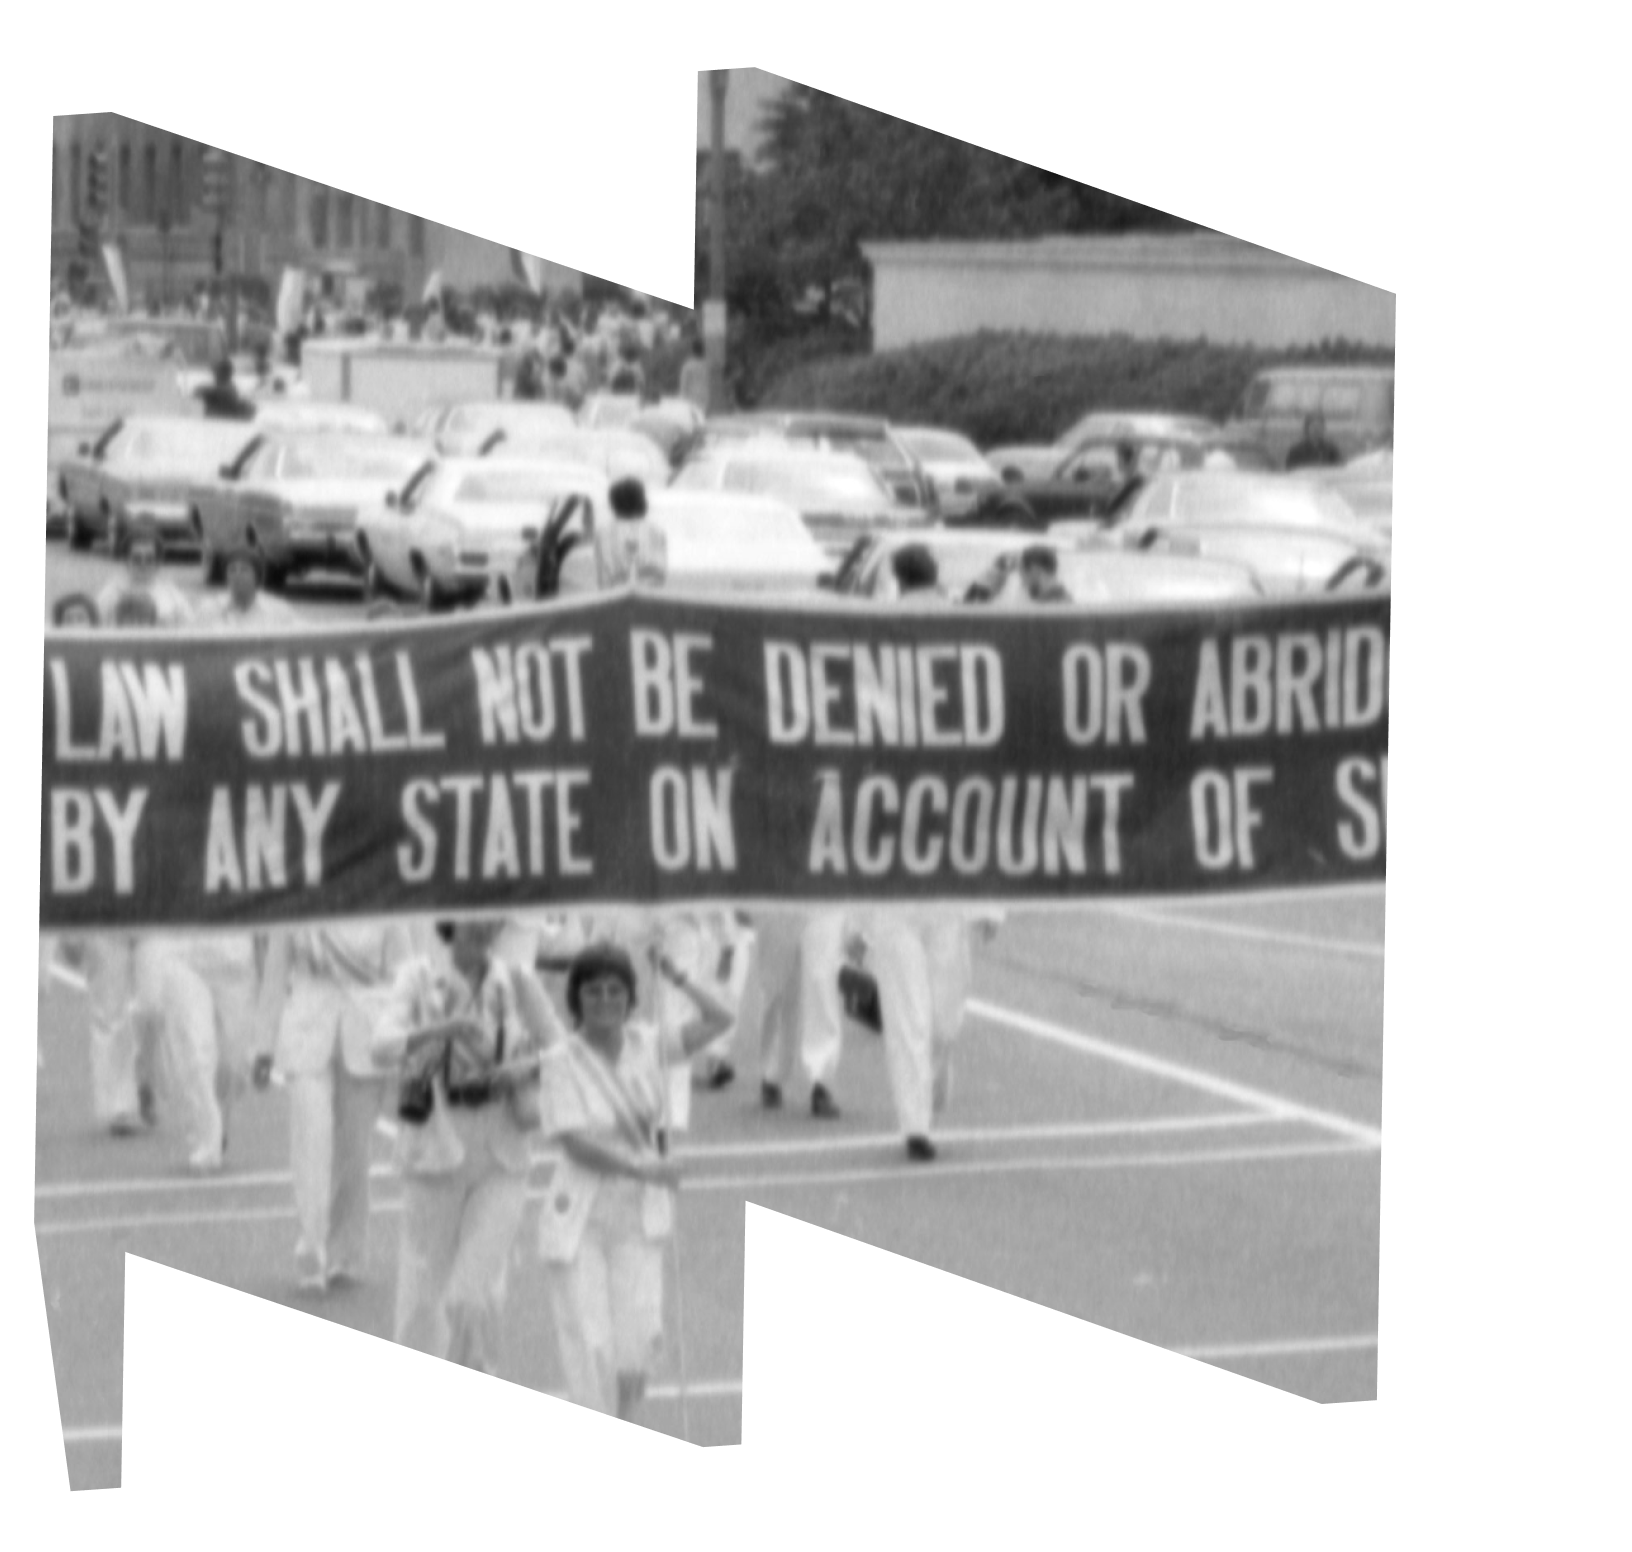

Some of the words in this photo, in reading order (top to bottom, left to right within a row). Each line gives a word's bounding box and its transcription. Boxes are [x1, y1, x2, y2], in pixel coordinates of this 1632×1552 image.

[50, 655, 188, 763] LAW
[232, 648, 446, 760] SHALL
[469, 633, 594, 746] NOT
[629, 627, 718, 739] BE
[762, 638, 1006, 748] DENIED
[1060, 641, 1152, 745] OR
[1189, 625, 1386, 740] ABRID
[49, 786, 149, 895] BY
[204, 781, 341, 894] ANY
[396, 768, 593, 883] STATE
[649, 764, 737, 872] ON
[808, 768, 1135, 877] ACCOUNT
[1189, 767, 1273, 871] OF
[1335, 752, 1388, 862] S
